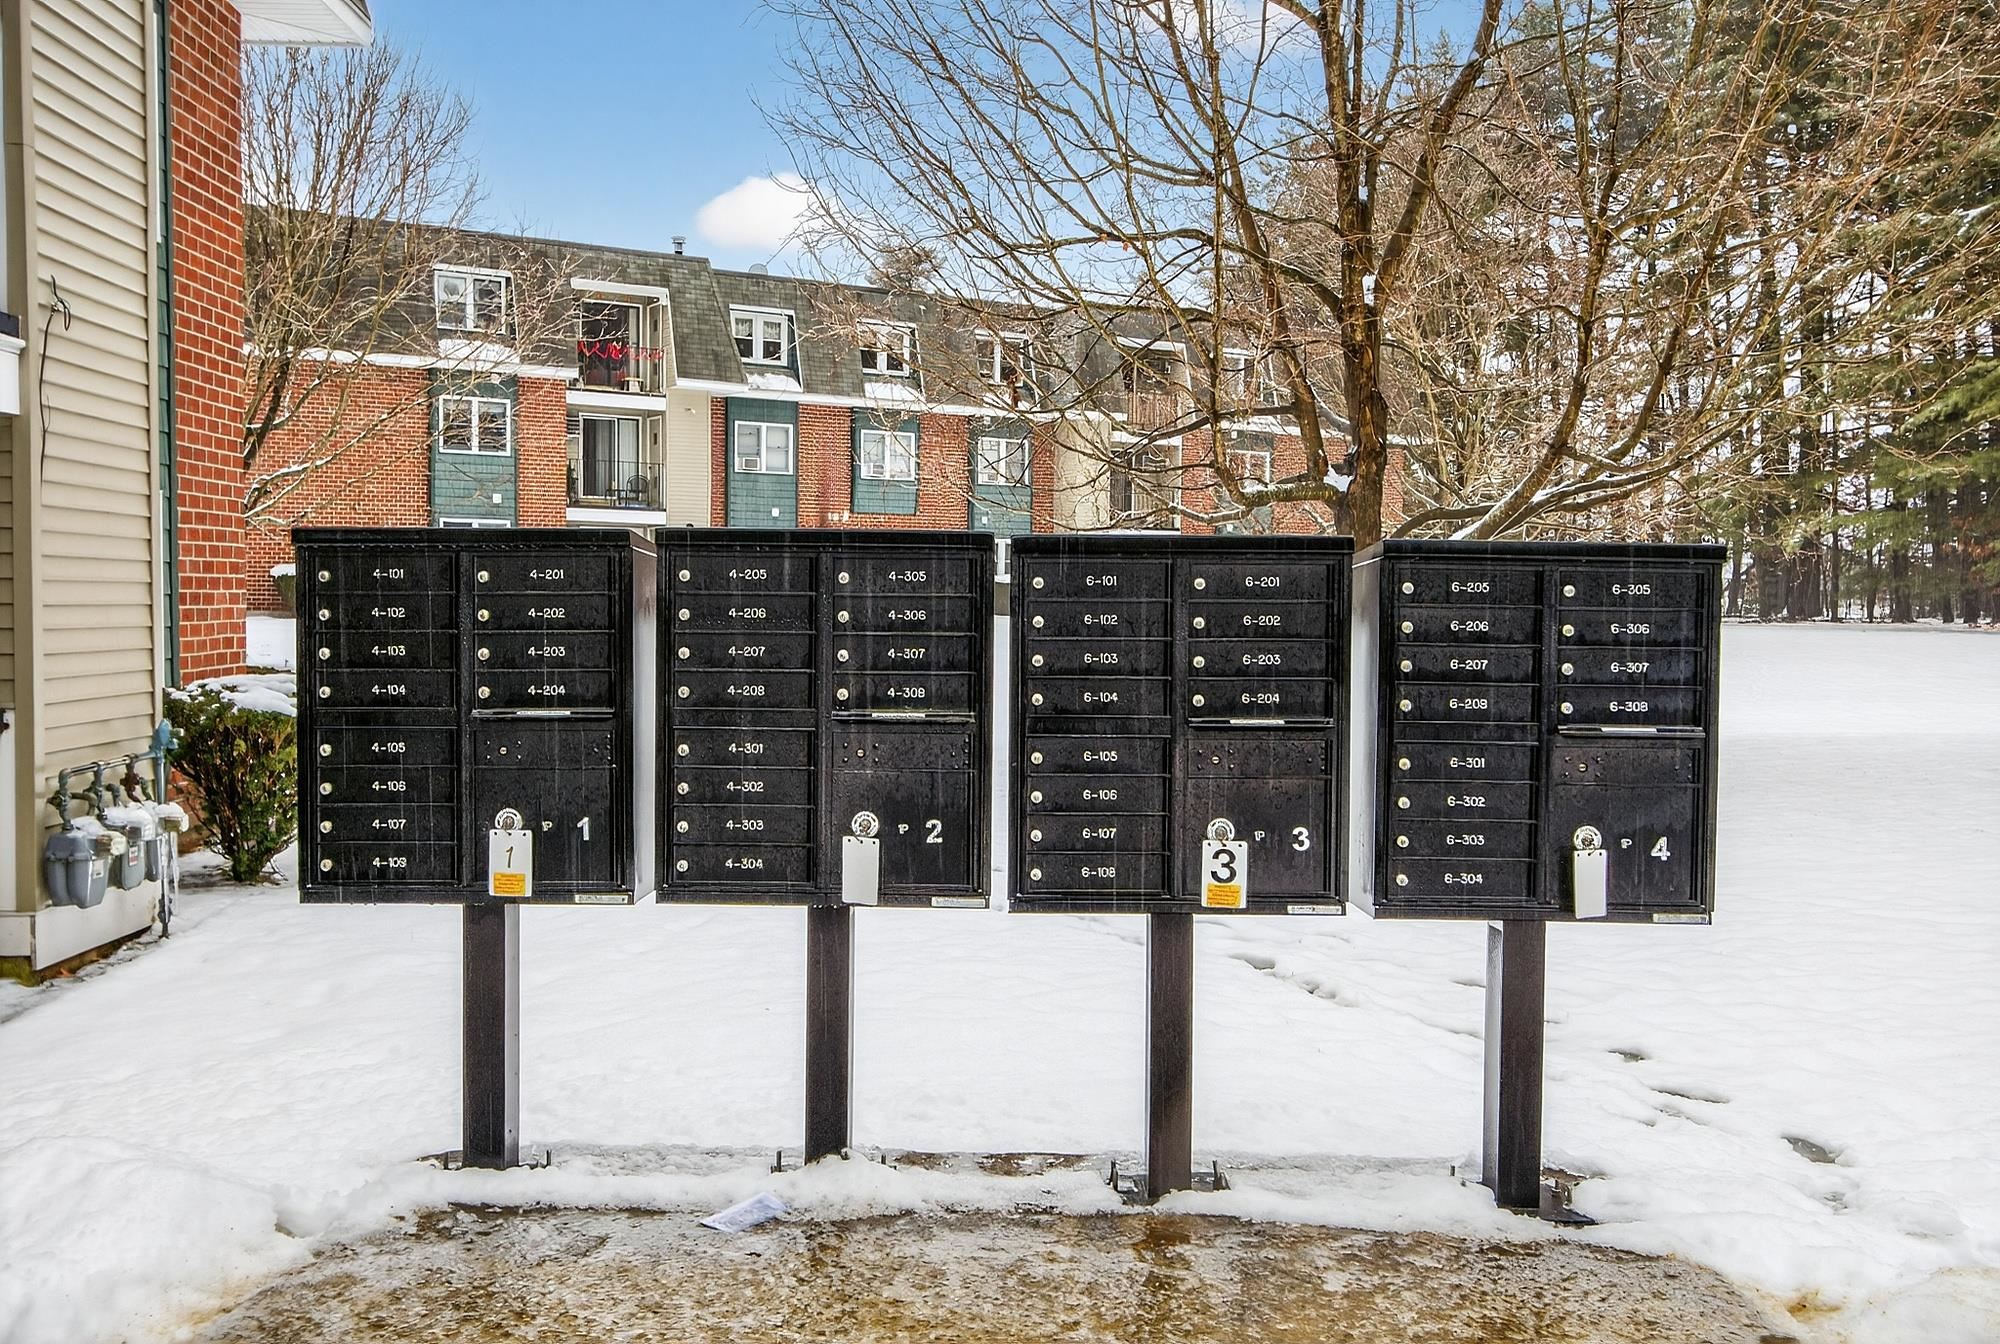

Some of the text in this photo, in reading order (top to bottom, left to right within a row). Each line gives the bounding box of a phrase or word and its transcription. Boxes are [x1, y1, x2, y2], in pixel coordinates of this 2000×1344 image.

[373, 568, 404, 579] 4-101
[529, 568, 564, 580] 4-201
[728, 568, 767, 580] 4-205
[888, 570, 927, 582] 4-305
[1086, 575, 1117, 586] 6-101
[1245, 576, 1280, 588] 6-201
[1451, 581, 1490, 593] 6-205
[1612, 583, 1651, 595] 6-305
[371, 607, 406, 618] 4-102
[527, 607, 566, 619] 4-202
[728, 607, 767, 619] 4-206
[888, 609, 927, 621] 4-306
[1084, 614, 1119, 625] 6-102
[1243, 615, 1281, 626] 6-202
[1450, 620, 1489, 632] 6-206
[1610, 623, 1650, 635] 6-306
[371, 645, 406, 656] 4-103
[527, 646, 566, 657] 4-203
[728, 645, 766, 657] 4-207
[887, 648, 926, 659] 4-307
[1083, 652, 1119, 664] 6-103
[1242, 654, 1281, 665] 6-203
[1449, 658, 1489, 670] 6-207
[1610, 661, 1650, 673] 6-307
[371, 684, 406, 696] 4-104
[527, 684, 566, 696] 4-204
[727, 685, 765, 697] 4-208
[887, 687, 926, 698] 4-308
[1083, 691, 1119, 703] 6-104
[1241, 692, 1280, 704] 6-204
[728, 742, 764, 754] 4-301
[1083, 750, 1118, 762] 6-105
[726, 780, 764, 793] 4-302
[1082, 789, 1118, 801] 6-106
[1447, 795, 1486, 807] 6-302
[371, 818, 407, 830] 4-107
[577, 817, 590, 841] 1
[725, 819, 764, 831] 4-303
[925, 819, 944, 844] 2
[1082, 827, 1117, 839] 6-107
[1292, 826, 1310, 852] 3
[1446, 834, 1485, 846] 6-303
[1650, 836, 1671, 861] 4
[505, 845, 514, 869] 1
[1081, 866, 1116, 878] 6-108
[1210, 848, 1237, 884] 3
